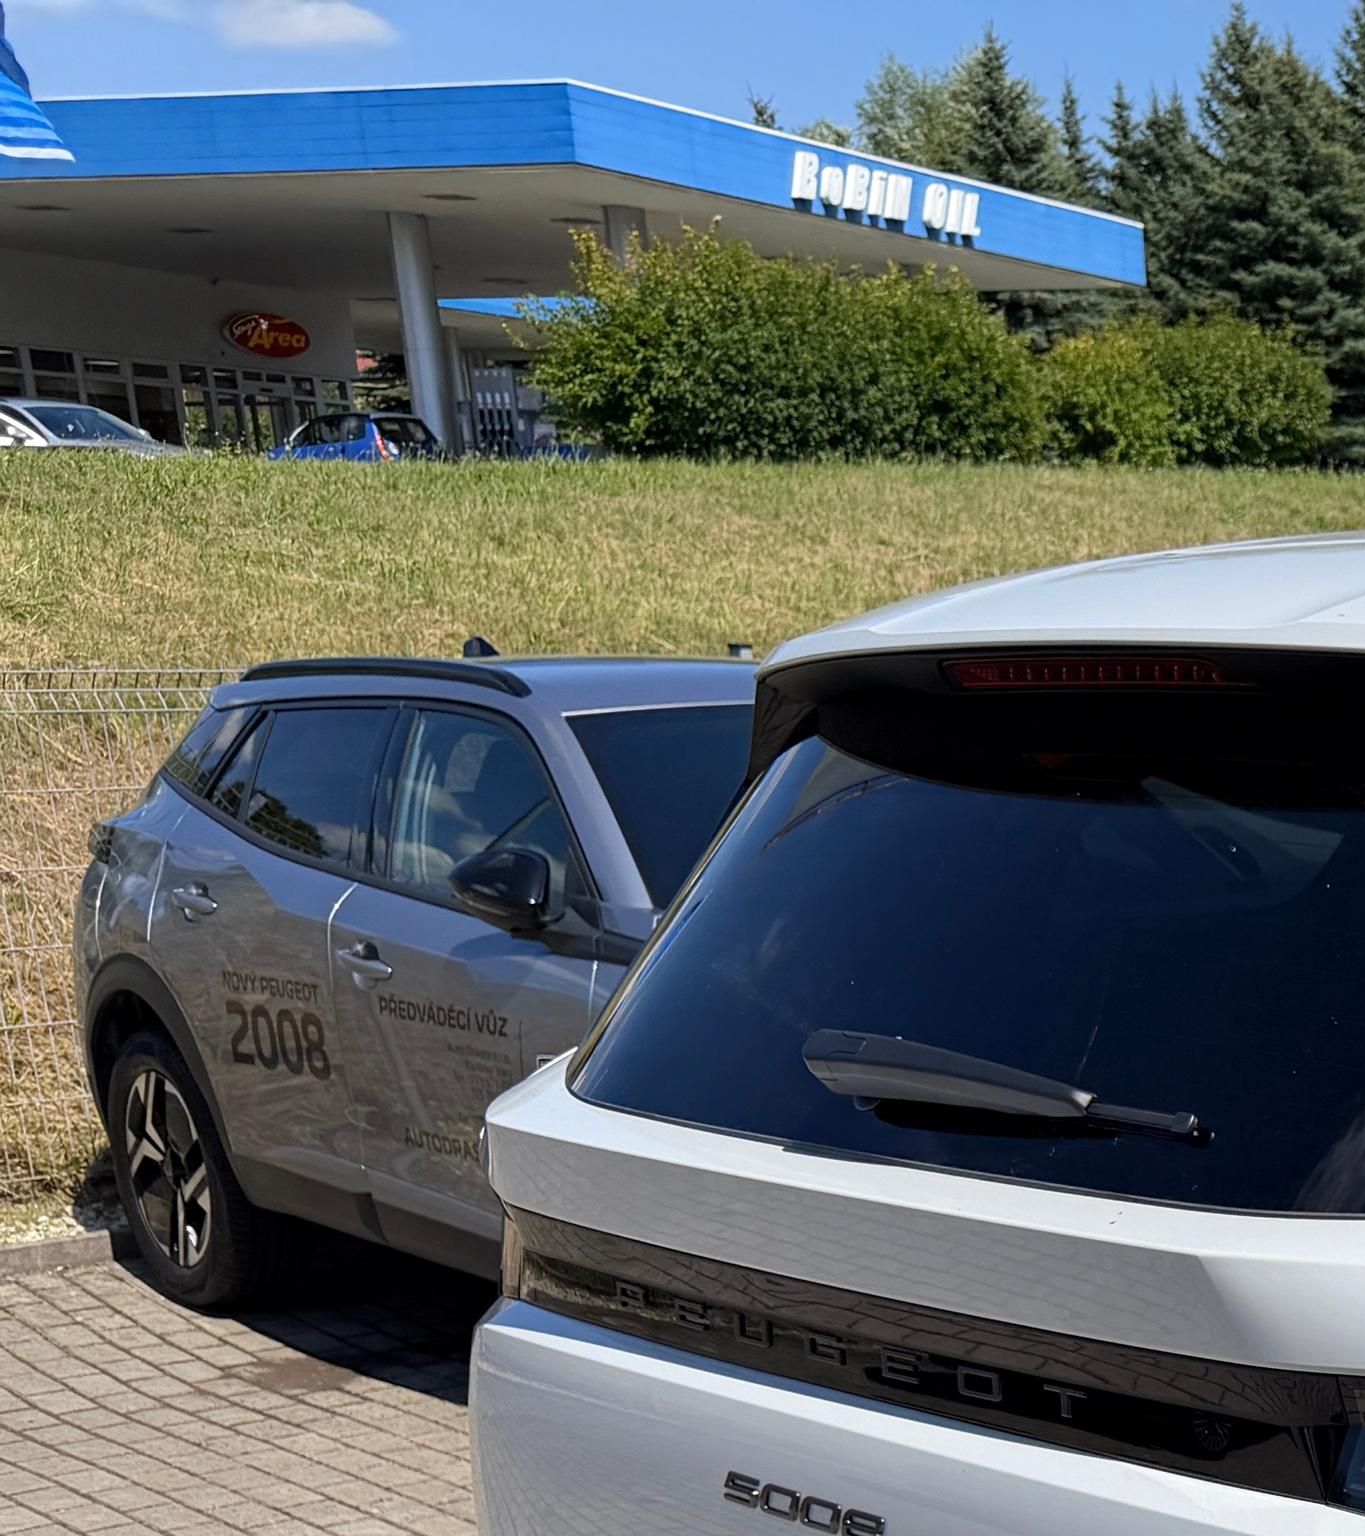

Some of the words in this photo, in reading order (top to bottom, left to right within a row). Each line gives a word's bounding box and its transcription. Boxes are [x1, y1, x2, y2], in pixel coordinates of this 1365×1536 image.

[922, 182, 982, 237] OIL
[248, 326, 306, 349] Area
[260, 976, 320, 1004] PEUGEOT
[225, 1000, 332, 1081] 2008
[474, 1008, 509, 1037] VŮZ
[405, 1127, 480, 1163] AUTODRAS
[615, 1280, 1087, 1420] PEUGEOT
